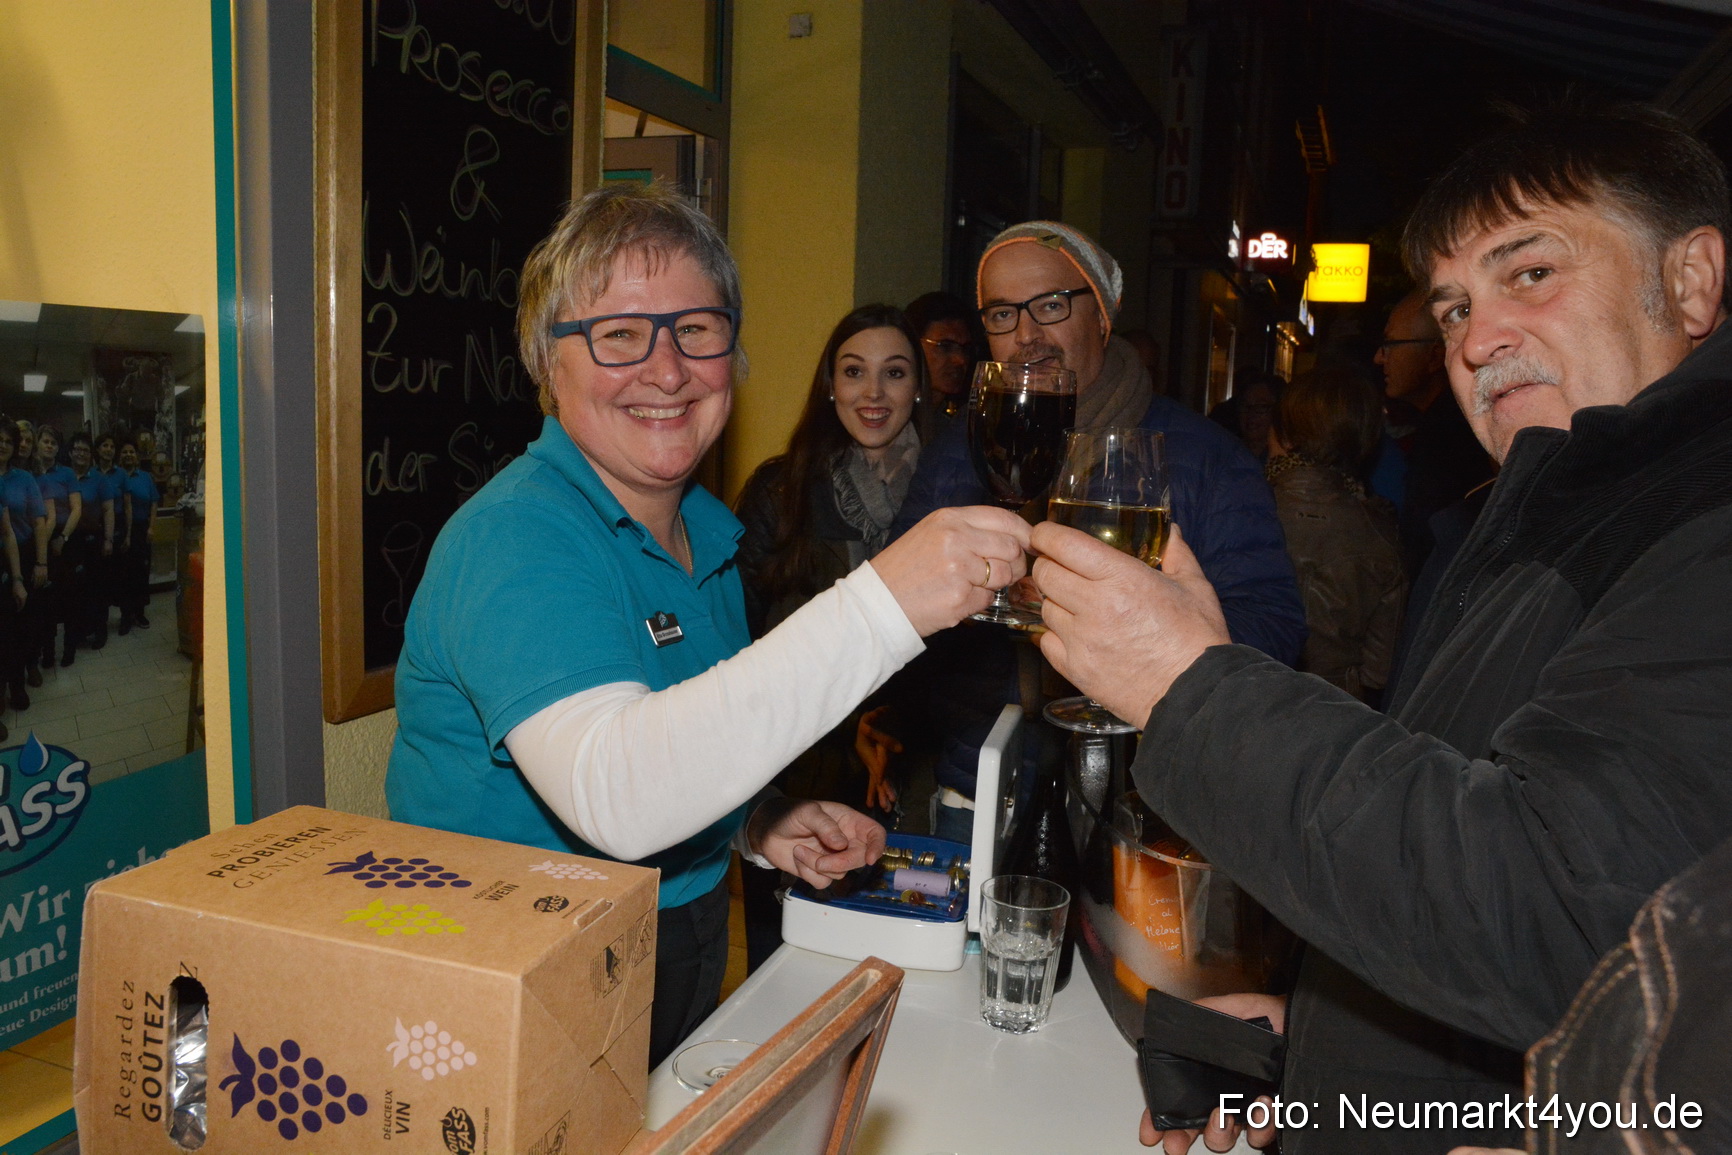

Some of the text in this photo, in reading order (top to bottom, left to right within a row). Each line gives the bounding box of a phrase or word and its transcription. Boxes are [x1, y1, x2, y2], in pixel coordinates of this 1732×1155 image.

[1164, 39, 1195, 210] KINO
[451, 125, 502, 222] &
[1248, 238, 1288, 259] DER
[366, 437, 439, 496] der
[206, 826, 333, 879] PROBIEREN
[211, 833, 279, 859] Sehen
[233, 828, 368, 889] GENIESSEN
[0, 885, 71, 939] Wir
[484, 883, 520, 901] WEIN
[114, 980, 137, 1122] Regardez
[138, 991, 164, 1123] GOÛTEZ
[383, 1089, 393, 1140] DÉLICIEUX
[395, 1101, 411, 1134] VIN
[451, 1107, 475, 1154] FASS
